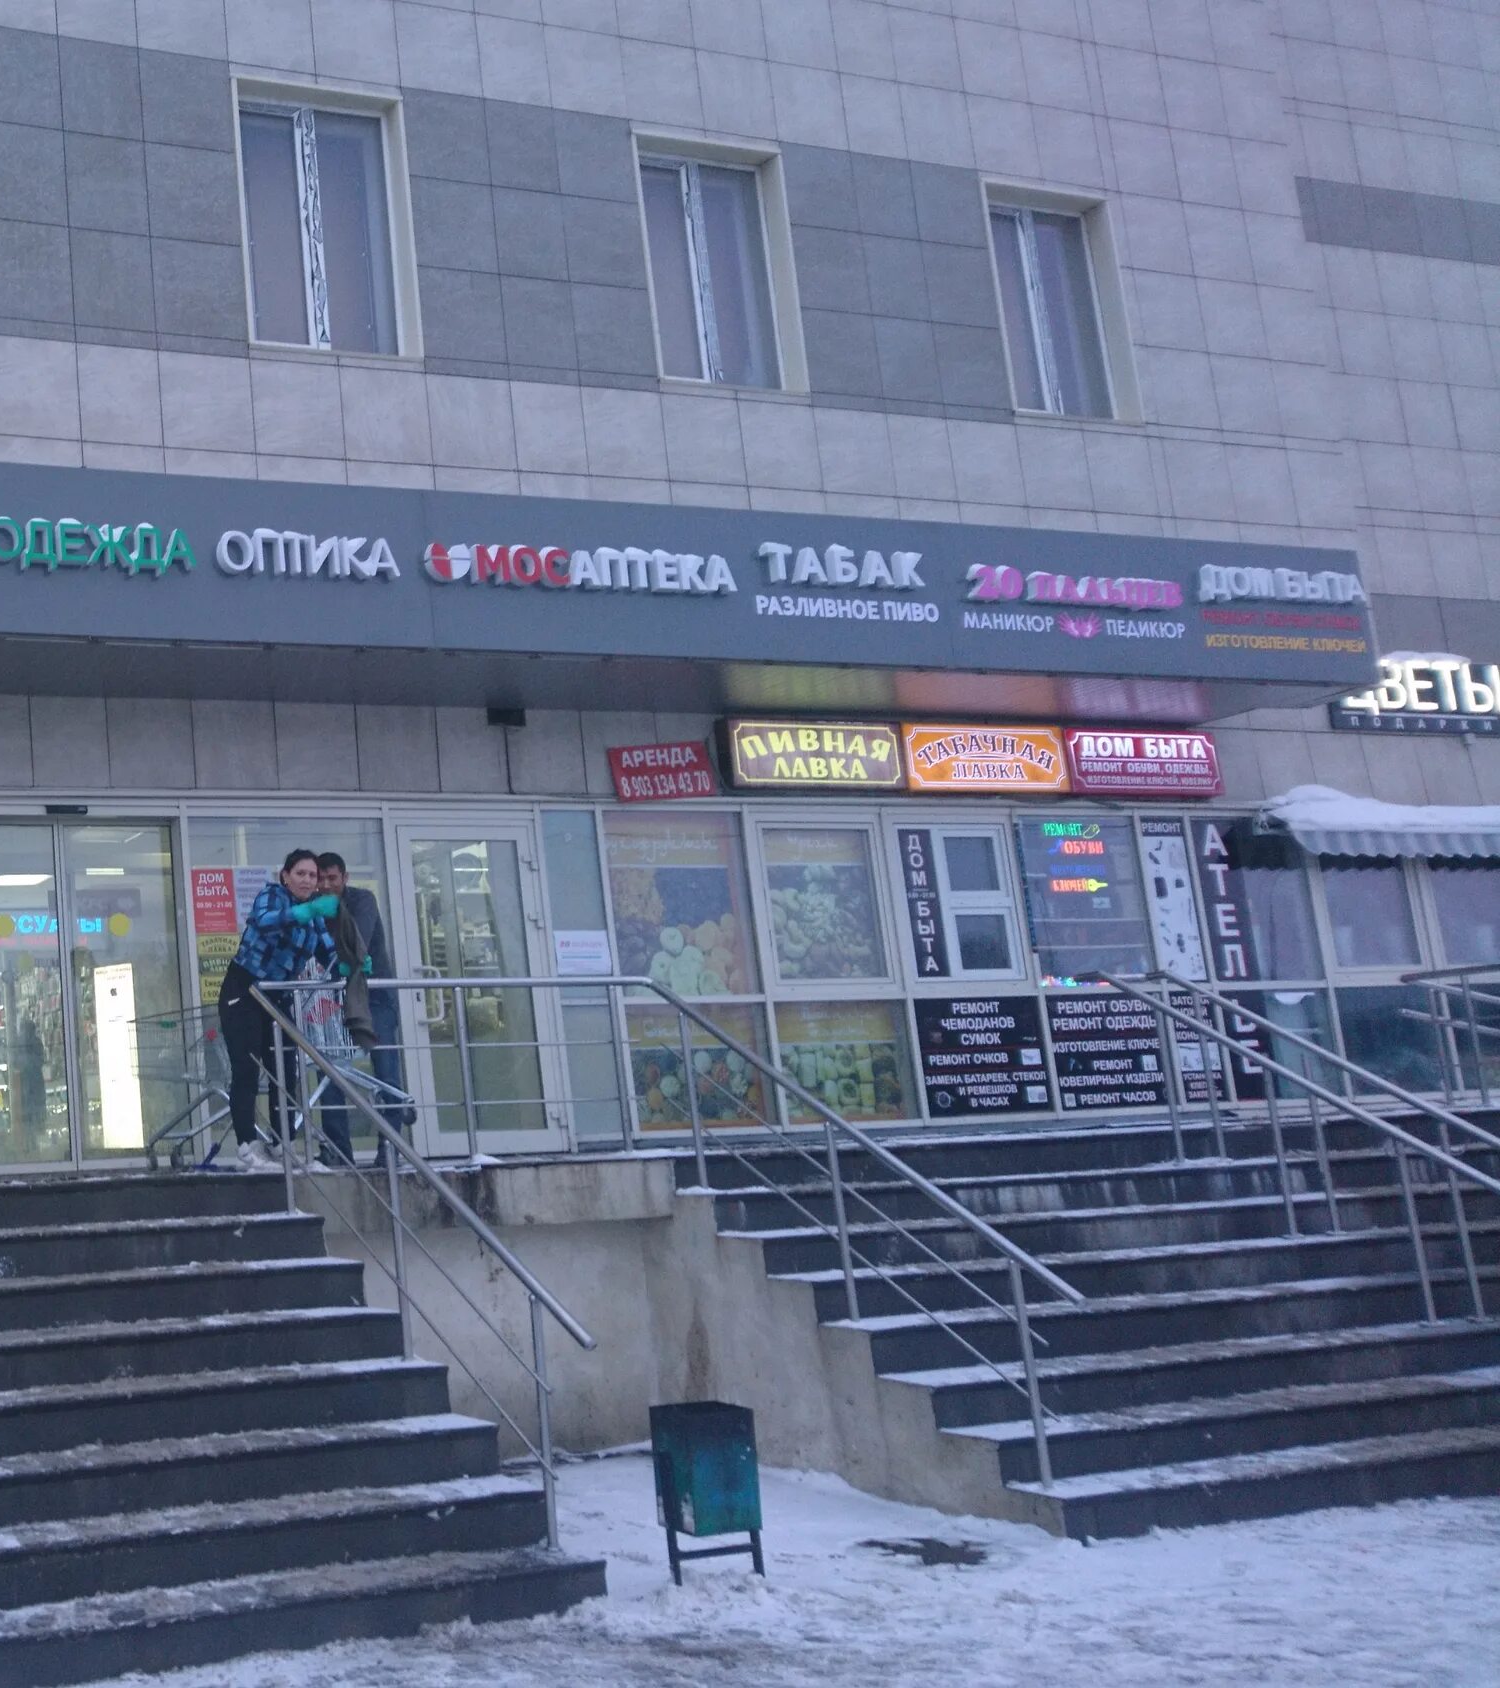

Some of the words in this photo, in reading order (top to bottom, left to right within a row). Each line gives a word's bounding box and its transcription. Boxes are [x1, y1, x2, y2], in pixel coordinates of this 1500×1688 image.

[216, 529, 401, 578] ОПТИКА
[757, 542, 926, 589] ТАБАК
[966, 564, 1025, 601] 20
[1199, 564, 1276, 601] ДОМ
[1274, 568, 1368, 603] БЫТА
[755, 595, 880, 621] РАЗЛИВНОЕ
[883, 601, 940, 623] ПИВО
[963, 611, 1055, 634] МАНИКЮР
[1105, 617, 1186, 640] ПЕДИКЮР
[1205, 633, 1309, 651] ИЗГОТОВЛЕНИЕ
[1312, 636, 1367, 653] КЛЮЧЕЙ
[1350, 715, 1493, 731] ПОДАРКИ
[740, 729, 892, 762] ПИВНАЯ
[915, 732, 1056, 772] ТАБАЧНАЯ
[1081, 736, 1135, 758] ДОМ
[1144, 737, 1208, 760] БЫТА
[621, 746, 698, 768] АРЕНДА
[773, 757, 869, 780] ЛАВКА
[951, 760, 1028, 781] ЛАВКА
[1080, 761, 1124, 773] РЕМОНТ
[620, 776, 631, 798] 8
[631, 775, 654, 797] 903
[654, 773, 677, 795] 134
[678, 771, 694, 793] 43
[1043, 823, 1083, 836] РЕМОНТ
[1142, 822, 1182, 833] РЕМОНТ
[1063, 840, 1105, 855] ОБУВИ
[908, 835, 928, 886] ДОМ
[198, 873, 225, 884] ДОМ
[196, 885, 229, 896] БЫТА
[917, 901, 939, 972] БЫТА
[952, 1001, 1000, 1015] РЕМОНТ
[1057, 1000, 1107, 1014] РЕМОНТ
[941, 1016, 1016, 1031] ЧЕМОДАНОВ
[1052, 1017, 1103, 1031] РЕМОНТ
[960, 1032, 1002, 1046] СУМОК
[1052, 1040, 1127, 1054] ИЗГОТОВЛЕНИЕ
[1127, 1038, 1161, 1050] КЛЮЧЕ
[929, 1053, 971, 1066] РЕМОНТ
[973, 1052, 1009, 1065] ОЧКОВ
[1093, 1059, 1133, 1071] РЕМОНТ
[925, 1074, 964, 1086] ЗАМЕНА
[1012, 1071, 1047, 1082] СТЕКОЛ
[1060, 1074, 1125, 1087] ЮВЕЛИРНЫХ
[1125, 1072, 1165, 1085] ИЗДЕЛИ
[959, 1086, 967, 1097] И
[967, 1084, 1018, 1096] РЕМЕШКОВ
[1080, 1093, 1121, 1105] РЕМОНТ
[1122, 1091, 1157, 1102] ЧАСОВ
[979, 1096, 1010, 1107] ЧАСАХ
